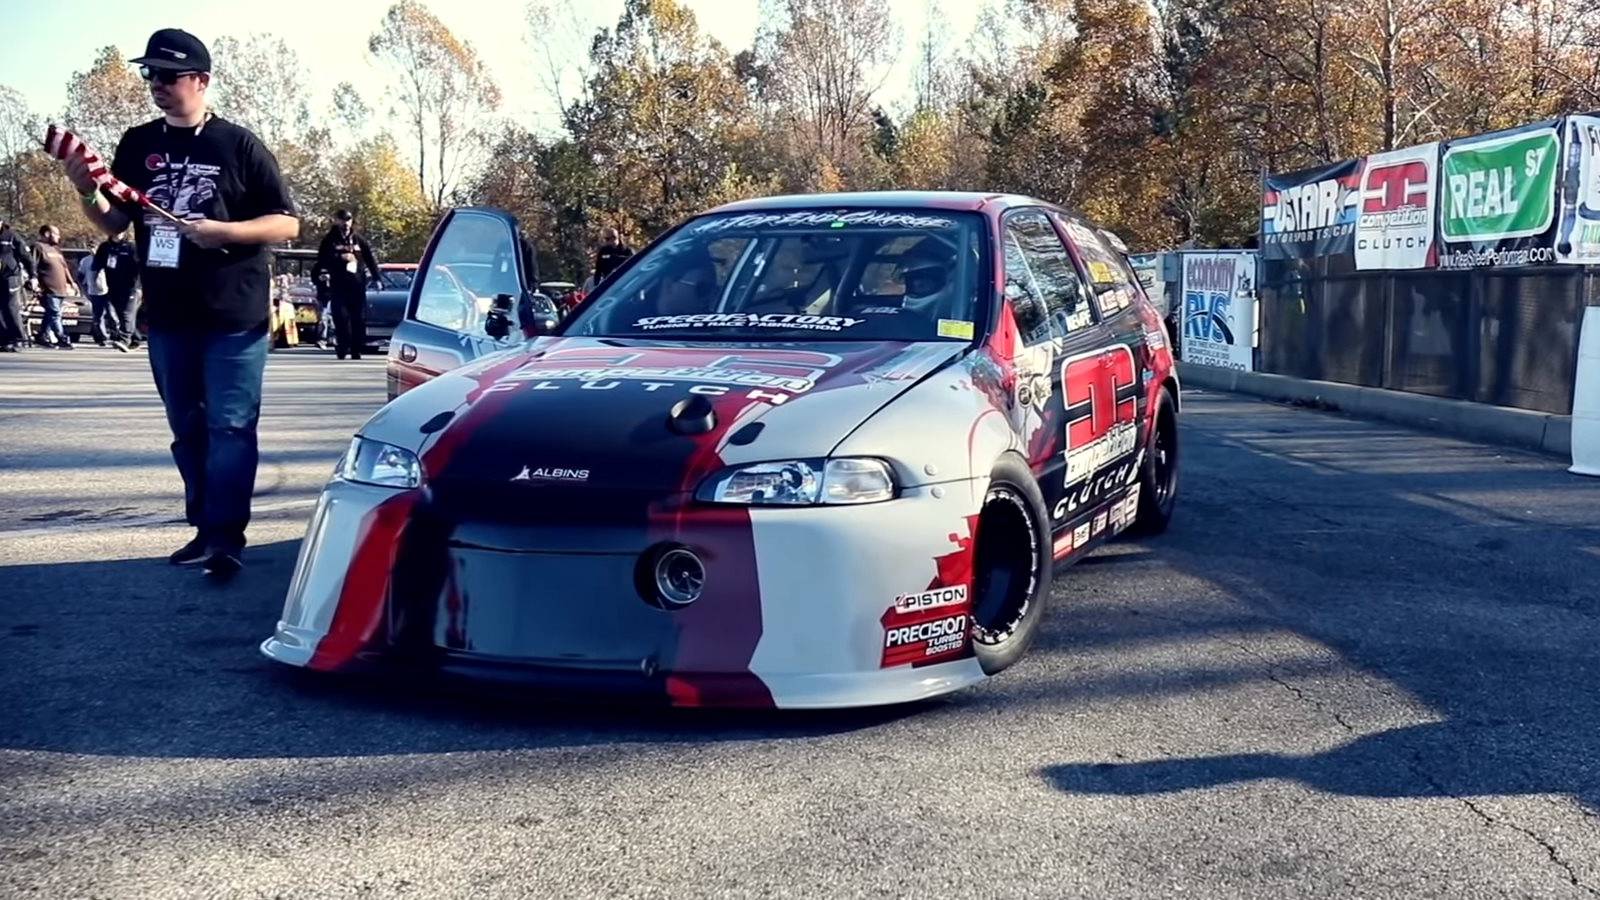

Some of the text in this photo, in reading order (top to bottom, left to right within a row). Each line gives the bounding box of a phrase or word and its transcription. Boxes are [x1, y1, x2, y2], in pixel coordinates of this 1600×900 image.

[1525, 147, 1546, 176] ST
[1450, 166, 1519, 219] REAL
[1358, 204, 1427, 230] competition
[155, 239, 175, 250] WS
[1358, 237, 1427, 250] CLUTCH
[632, 313, 865, 327] SPEEDFACTORY
[643, 322, 690, 330] TUNING
[707, 320, 744, 328] RACE
[748, 321, 842, 332] FABRICATION
[1184, 291, 1231, 343] RVS
[509, 365, 817, 393] competition
[483, 381, 789, 405] CLUTCH
[533, 467, 590, 479] ALBINS
[1053, 463, 1129, 520] CLUTCH
[886, 615, 966, 647] PRECISION
[927, 632, 964, 647] TURBO
[925, 641, 963, 656] BOOSTED
